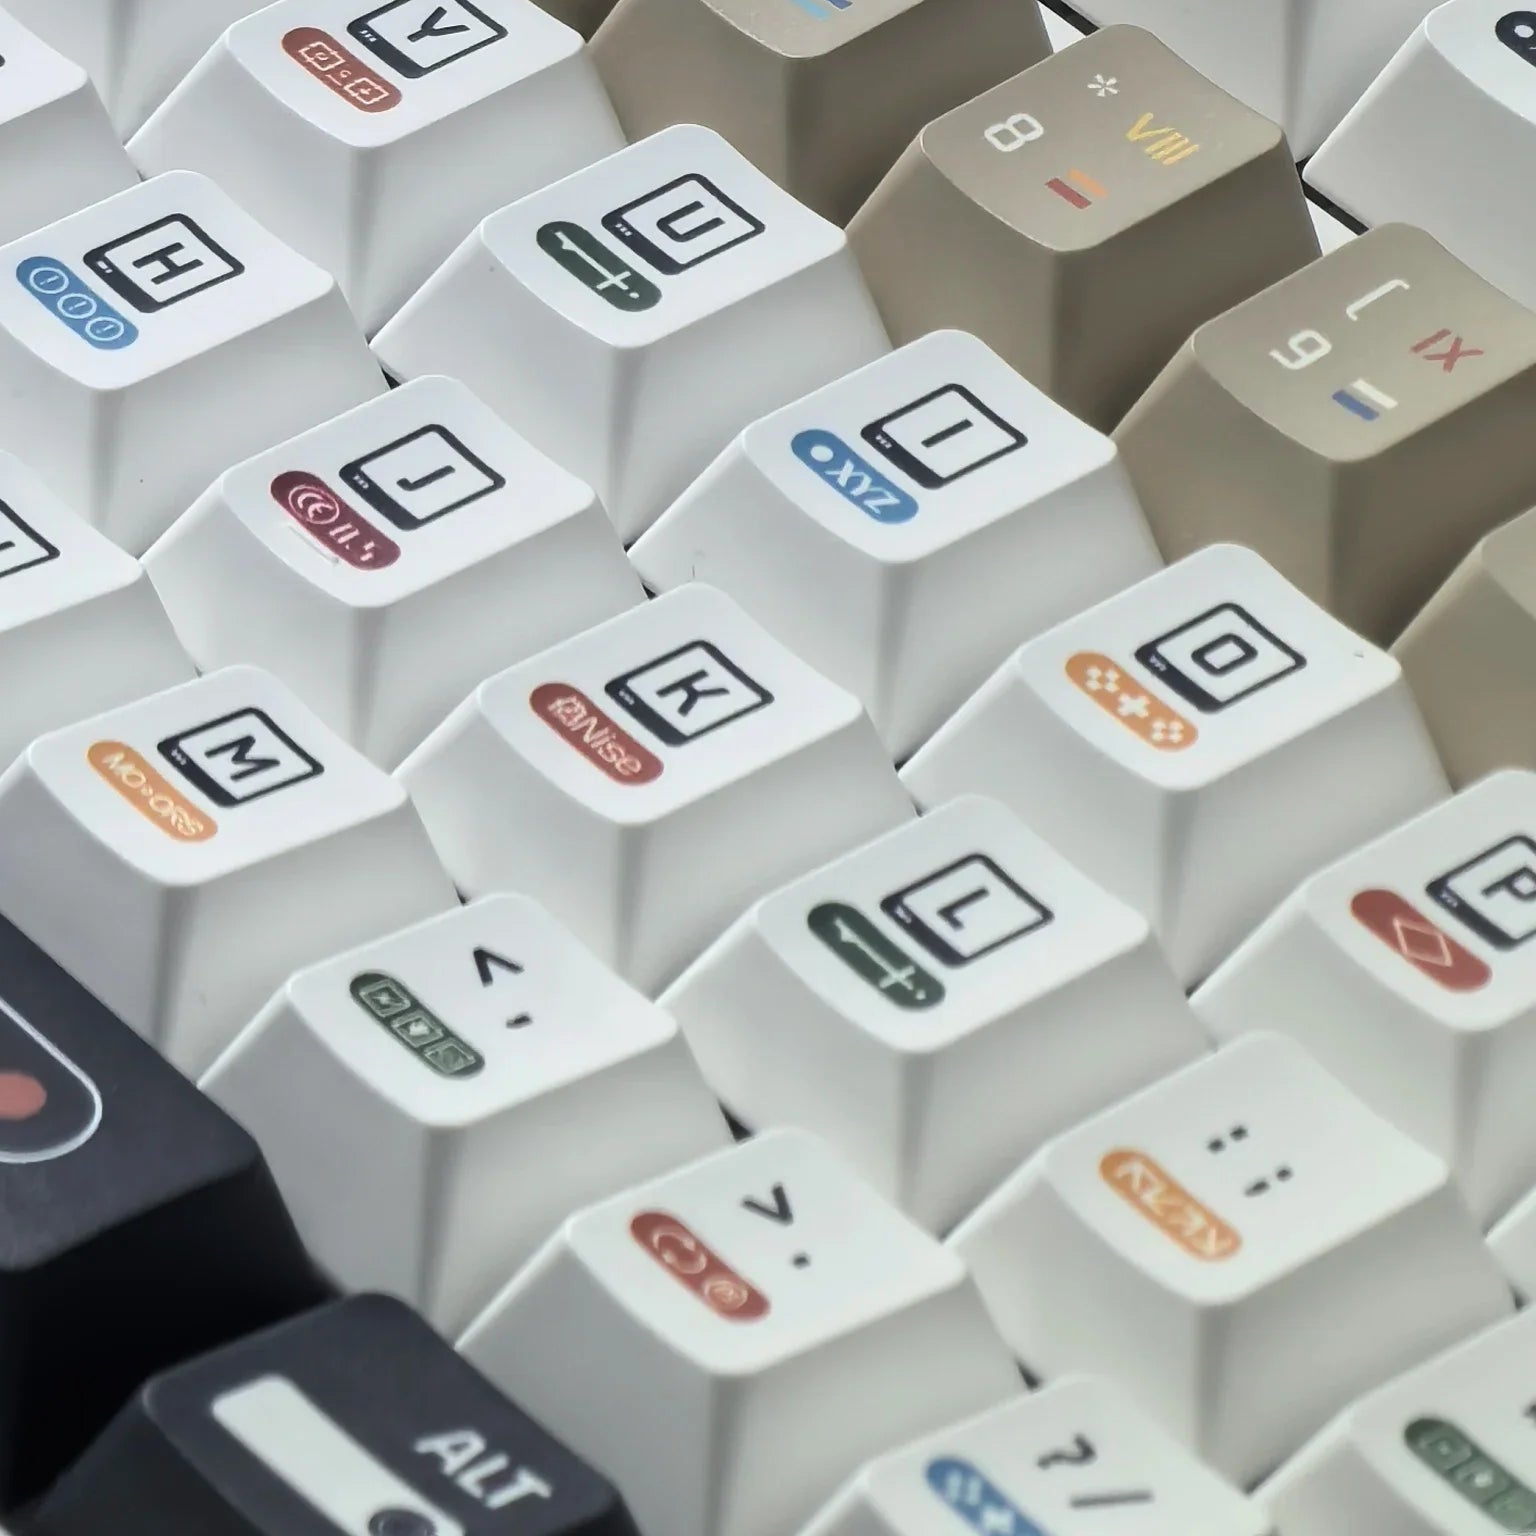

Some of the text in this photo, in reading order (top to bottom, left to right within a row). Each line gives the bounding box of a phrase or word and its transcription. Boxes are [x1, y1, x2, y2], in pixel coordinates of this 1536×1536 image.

[407, 7, 469, 43] Y
[984, 113, 1044, 152] 8
[1127, 113, 1199, 165] VIII
[656, 201, 724, 242] U
[133, 242, 203, 284] H
[1270, 330, 1332, 369] 9
[1411, 329, 1483, 372] IX
[397, 466, 455, 491] J
[825, 459, 900, 514] XYZ
[1191, 633, 1257, 675] O
[656, 670, 729, 716] K
[205, 735, 280, 781] M
[1481, 866, 1536, 902] P
[936, 887, 991, 931] L
[415, 1429, 552, 1510] ALT
